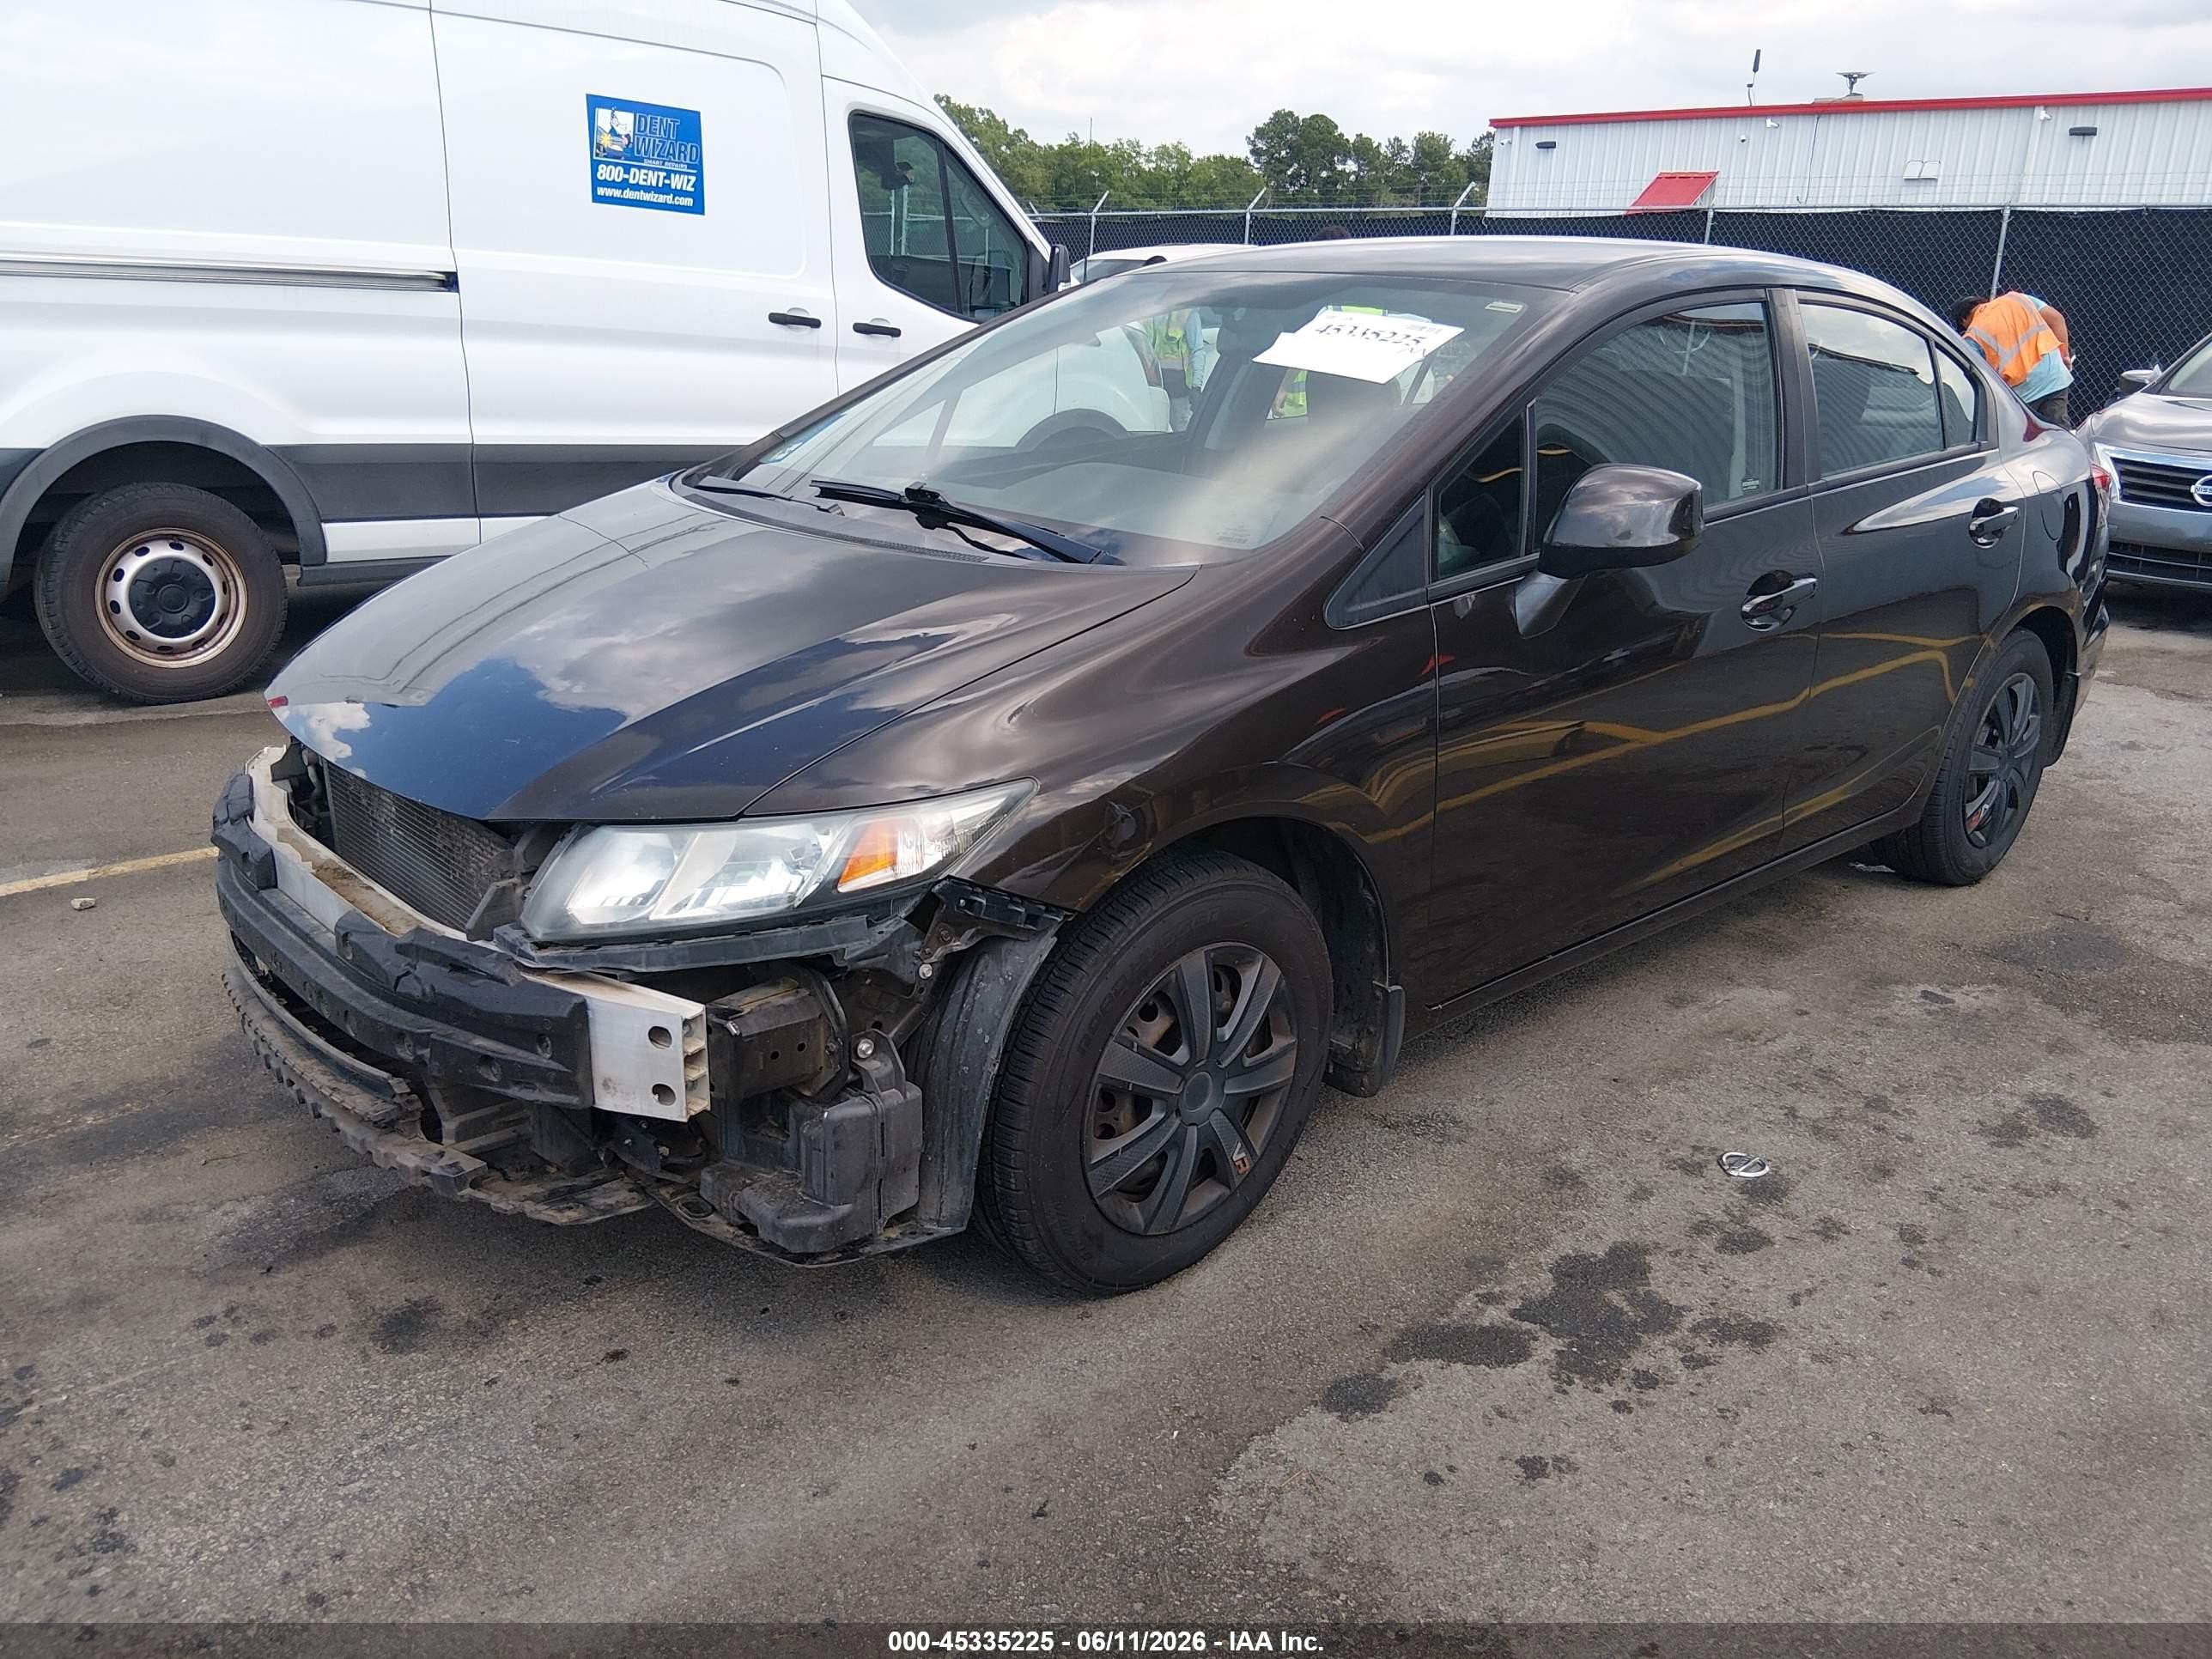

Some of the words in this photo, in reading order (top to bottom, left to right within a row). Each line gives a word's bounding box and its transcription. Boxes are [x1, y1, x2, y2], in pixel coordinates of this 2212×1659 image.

[635, 112, 680, 139] DENT
[635, 135, 701, 164] WIZARD
[643, 158, 663, 167] SMART
[597, 164, 696, 191] 800-DENT-WIZ
[597, 186, 694, 207] www.dentwizard.com
